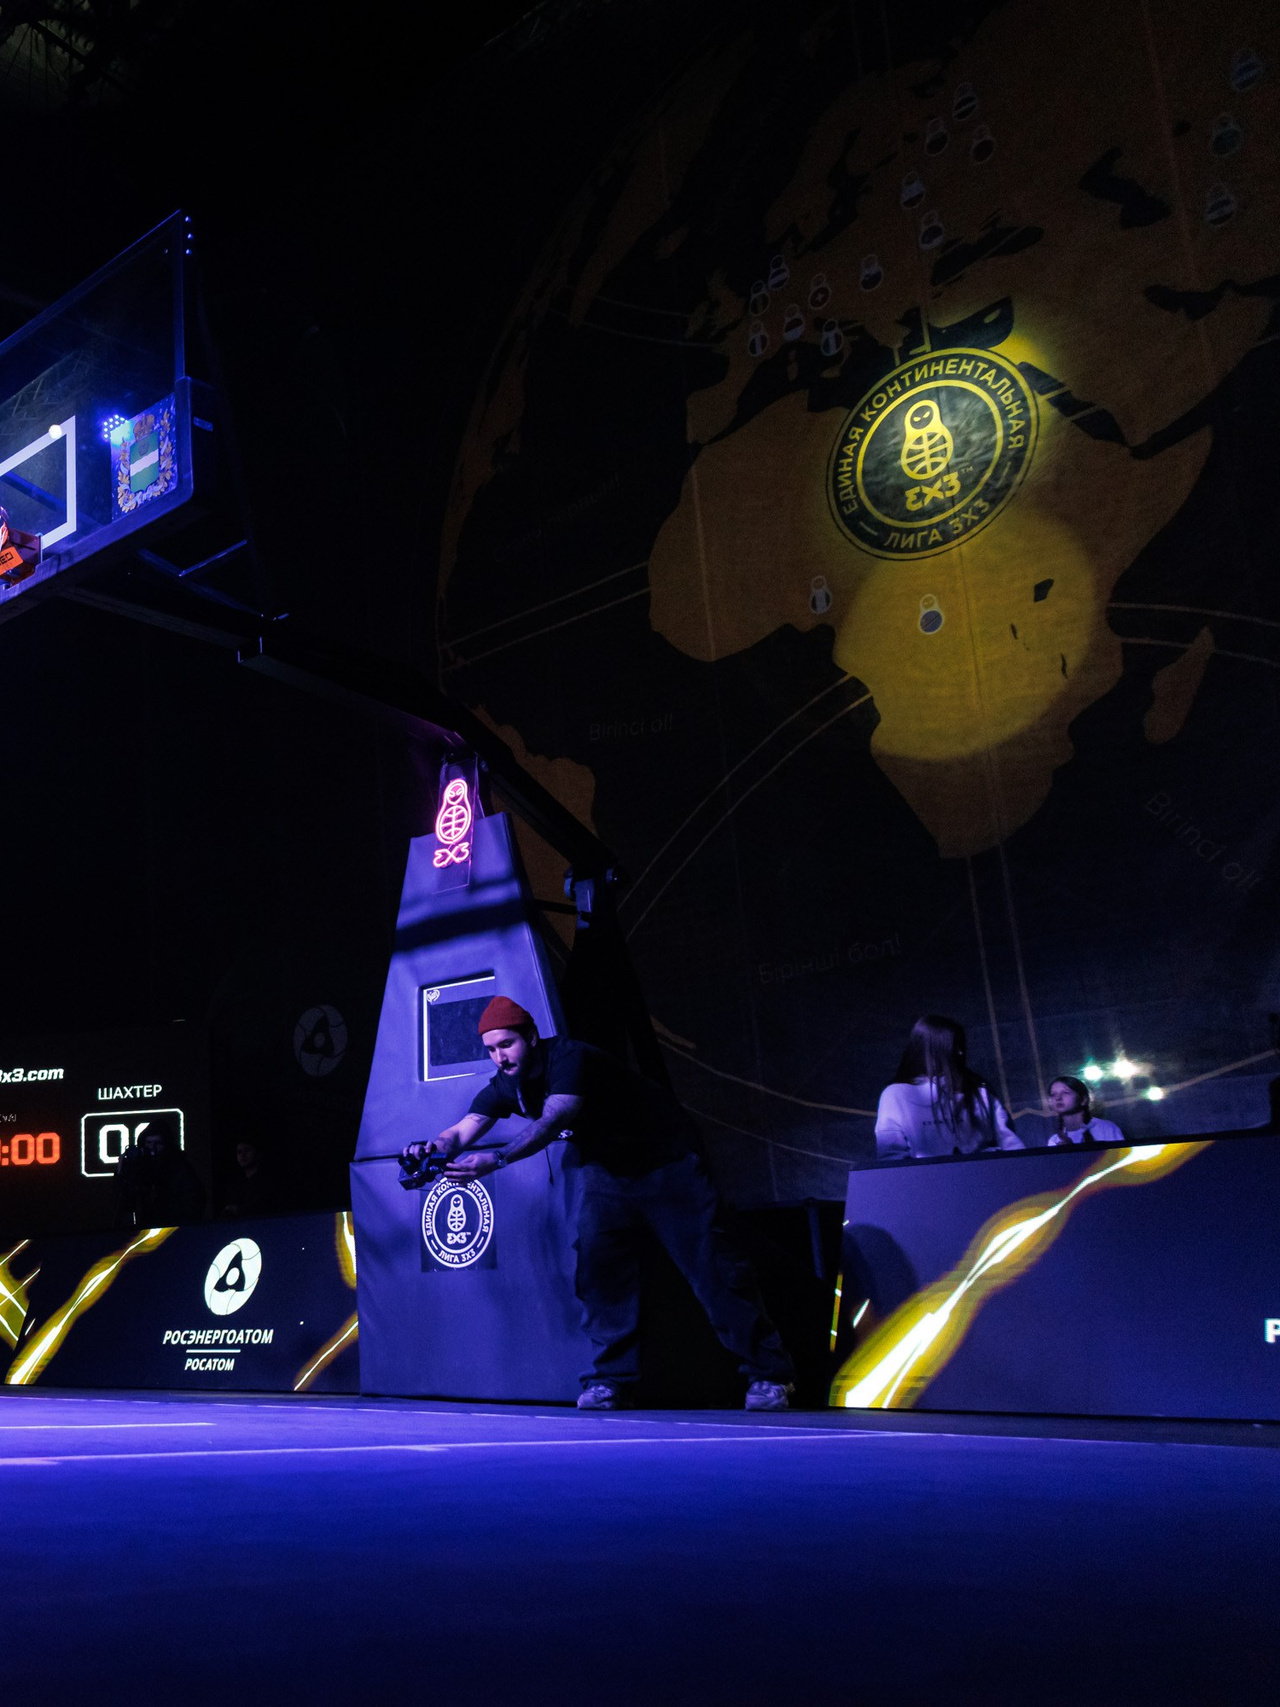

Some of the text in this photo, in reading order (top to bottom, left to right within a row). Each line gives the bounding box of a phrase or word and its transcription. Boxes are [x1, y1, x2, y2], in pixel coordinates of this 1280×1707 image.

[838, 358, 1026, 515] ЕДИНАЯ КОНТИНЕНТАЛЬНАЯ
[884, 528, 943, 549] ЛИГА
[97, 1084, 163, 1101] ШАХТЕР
[425, 1194, 438, 1236] ЕДИНАЯ
[438, 1250, 460, 1263] ЛИГА
[162, 1328, 275, 1345] РОСЭНЕРГОАТОМ
[184, 1357, 236, 1372] РОСАТОМ
